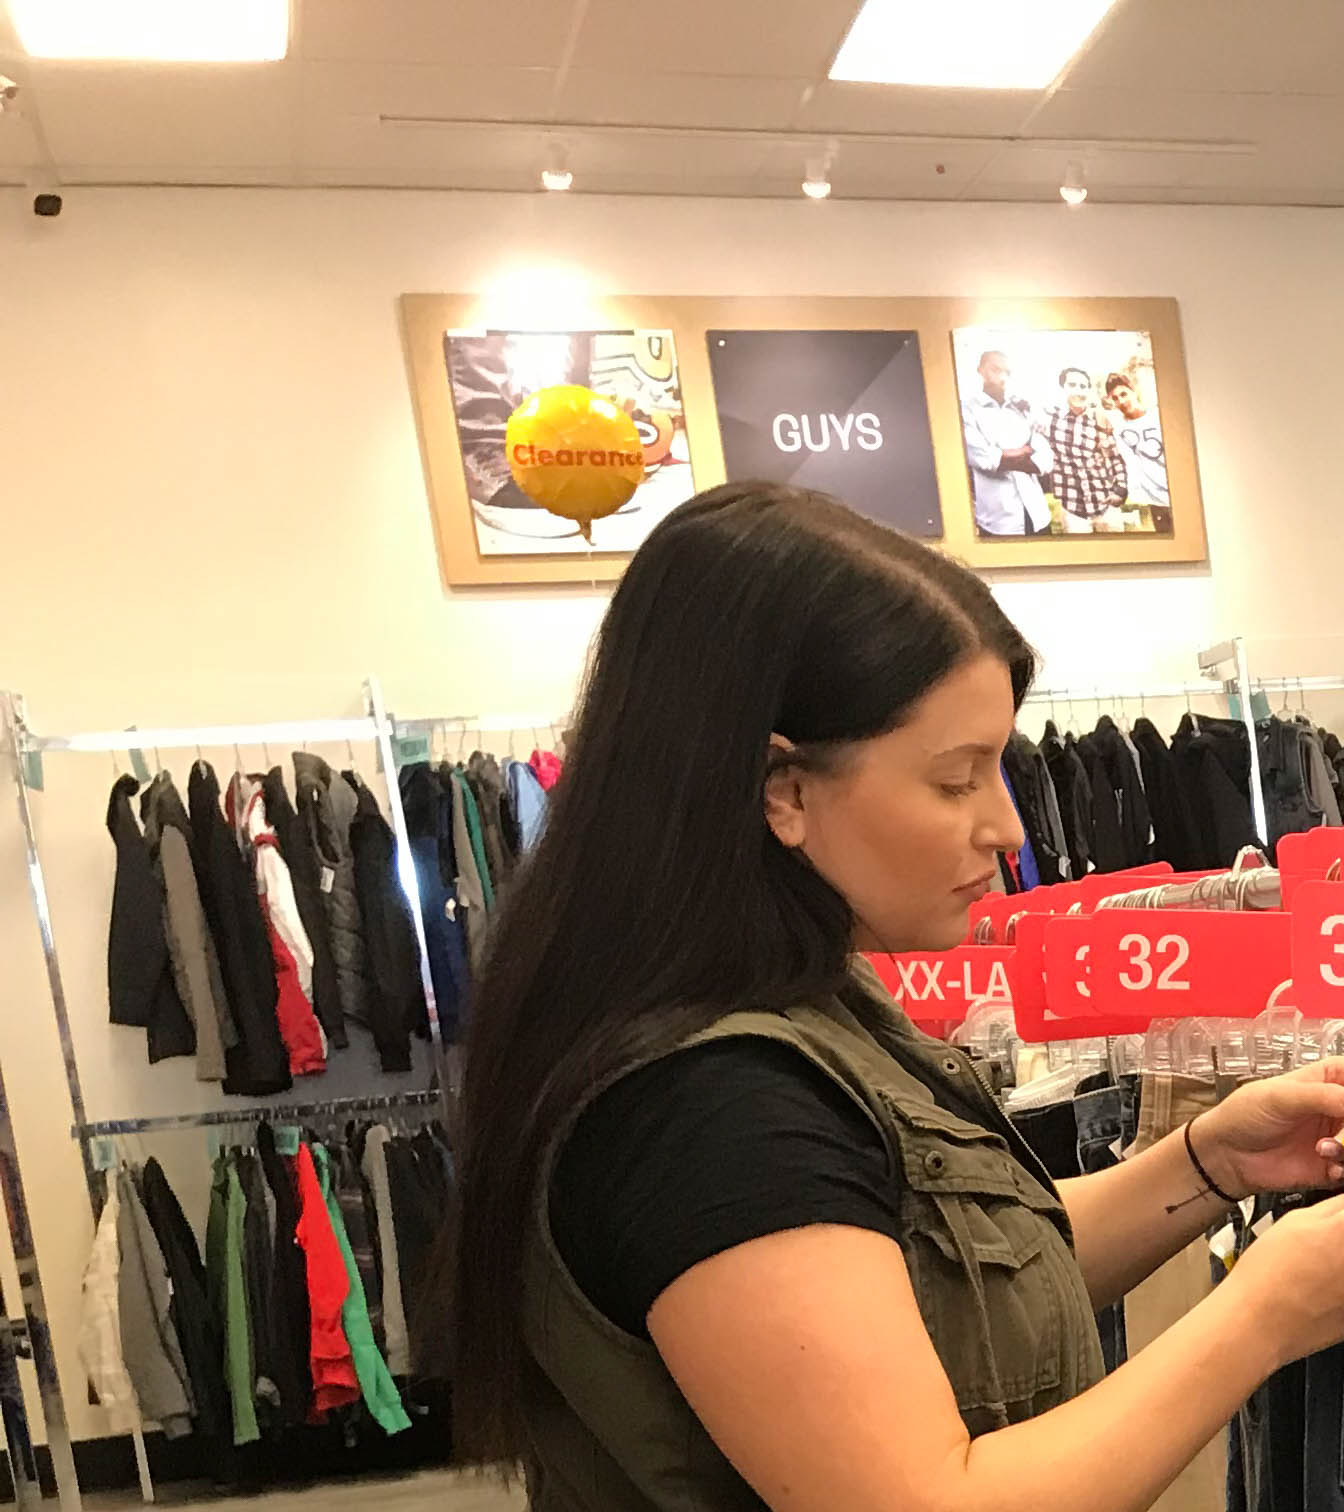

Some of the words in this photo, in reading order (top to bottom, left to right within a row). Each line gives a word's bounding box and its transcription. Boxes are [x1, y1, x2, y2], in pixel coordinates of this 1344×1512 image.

[772, 412, 884, 453] GUYS
[894, 960, 1014, 1001] XX-LA
[1118, 933, 1192, 991] 32
